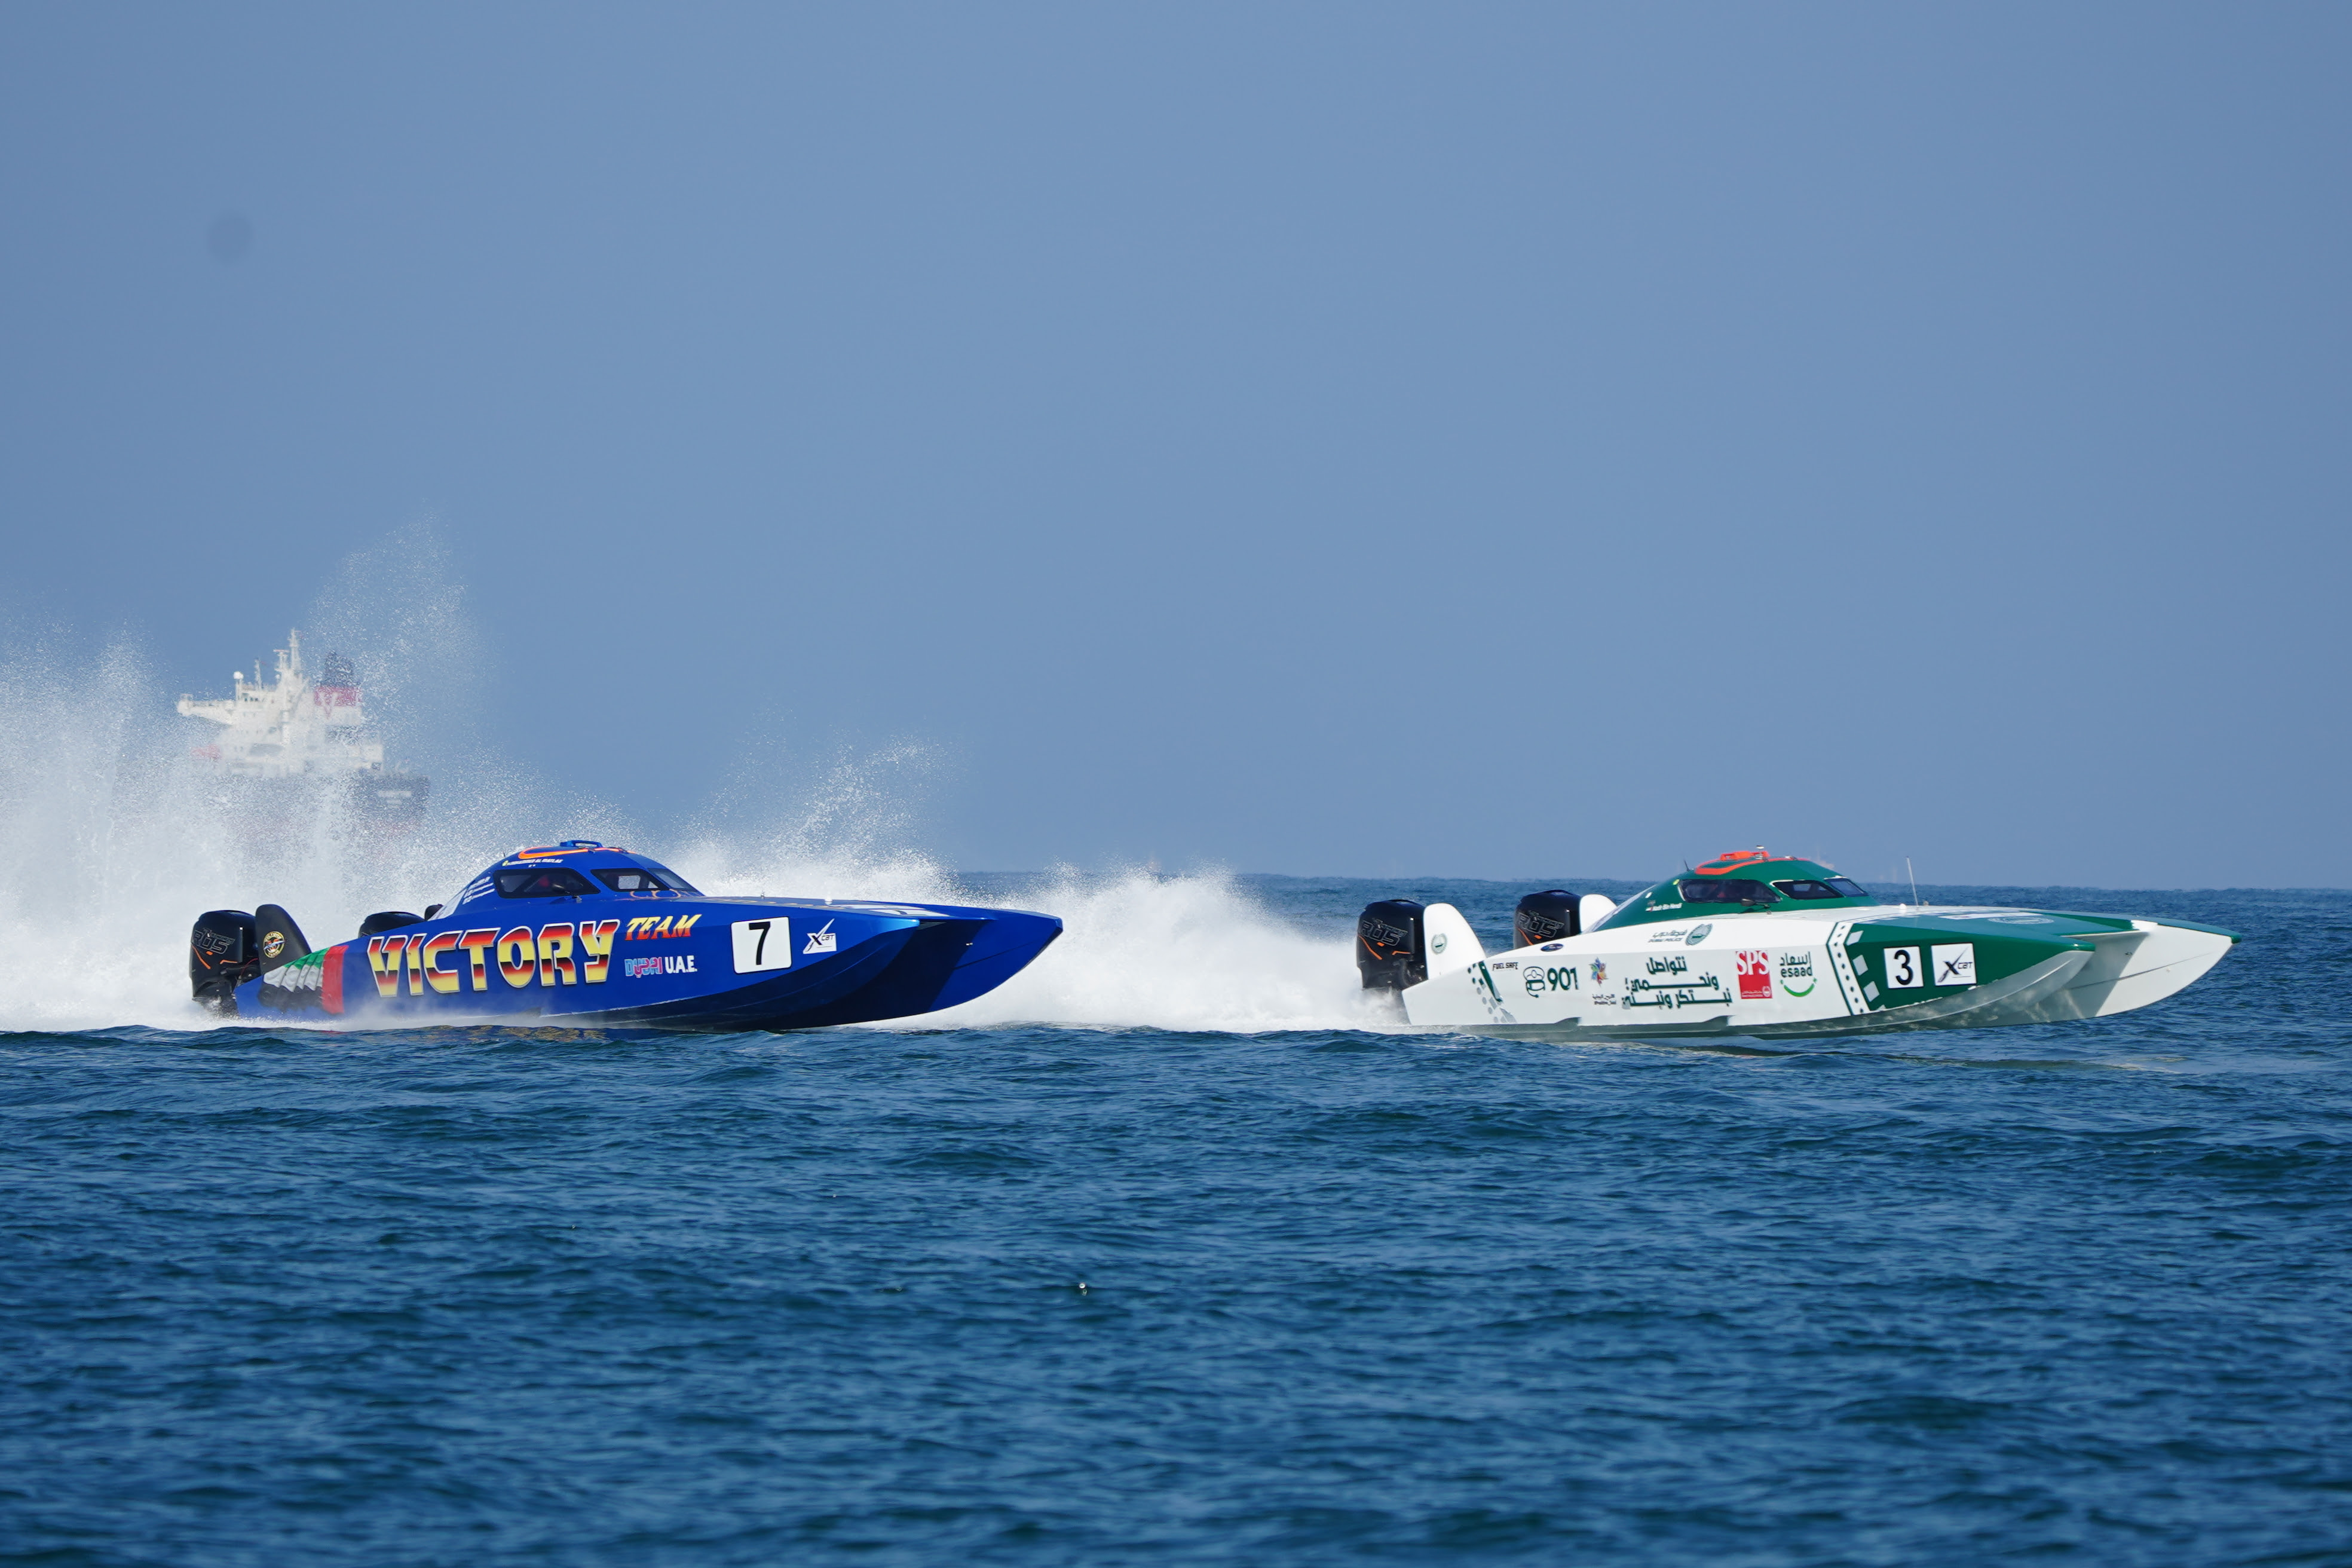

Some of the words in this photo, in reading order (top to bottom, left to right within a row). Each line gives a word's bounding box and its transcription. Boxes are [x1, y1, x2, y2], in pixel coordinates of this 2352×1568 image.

[624, 914, 702, 941] TEAM
[749, 921, 771, 966] 7
[367, 919, 620, 997] VICTORY
[664, 956, 698, 974] U.A.E.
[1646, 956, 1688, 975] نتواصل
[1735, 950, 1770, 975] SPS
[1894, 950, 1914, 985] 3
[1547, 966, 1579, 991] 901
[1780, 966, 1812, 978] esaad
